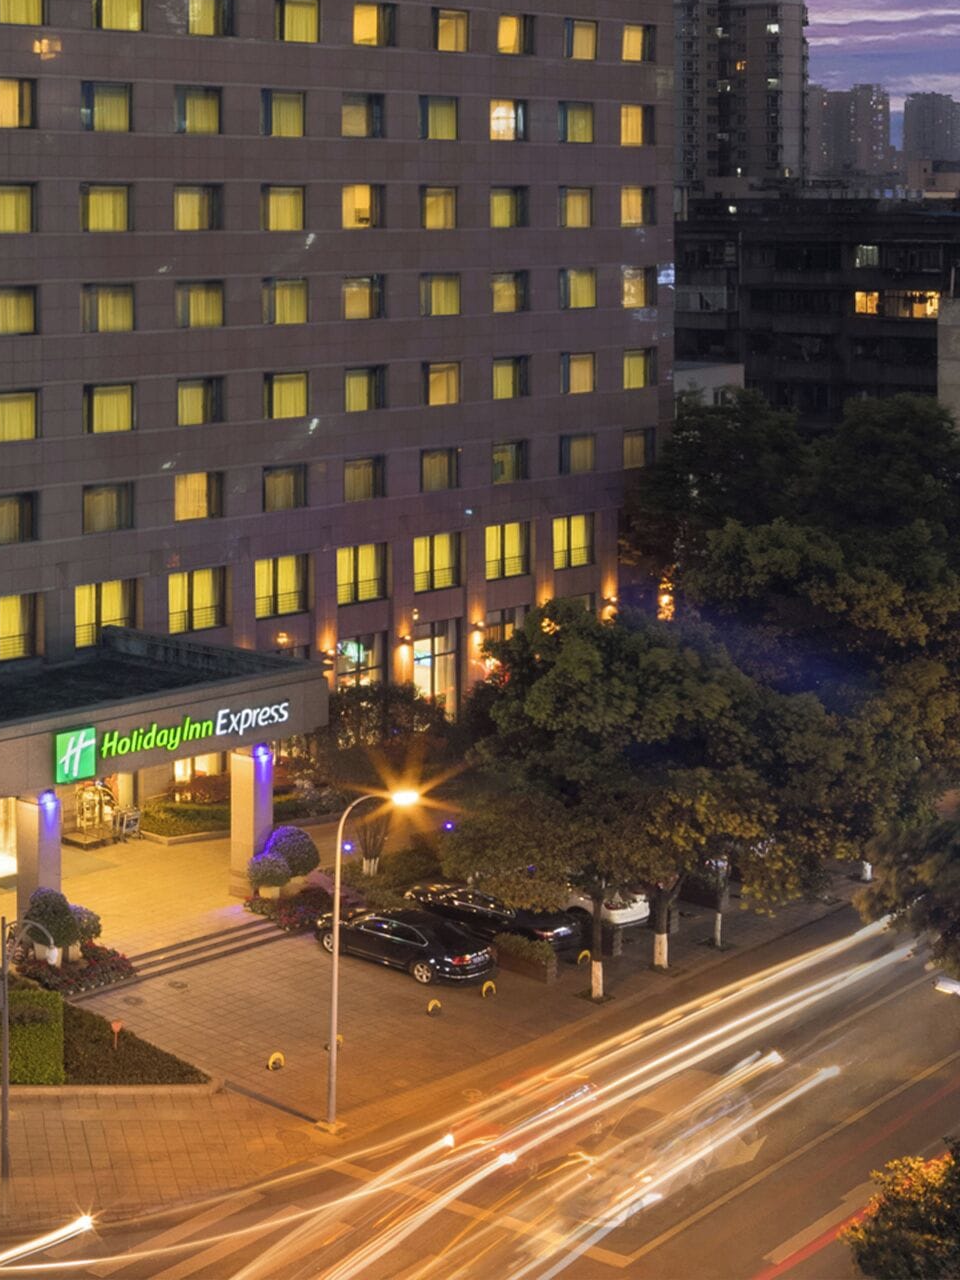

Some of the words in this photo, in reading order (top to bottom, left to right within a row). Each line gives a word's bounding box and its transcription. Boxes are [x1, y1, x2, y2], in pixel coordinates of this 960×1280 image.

[101, 723, 181, 759] Holiday
[182, 716, 213, 742] Inn
[215, 702, 289, 736] Express
